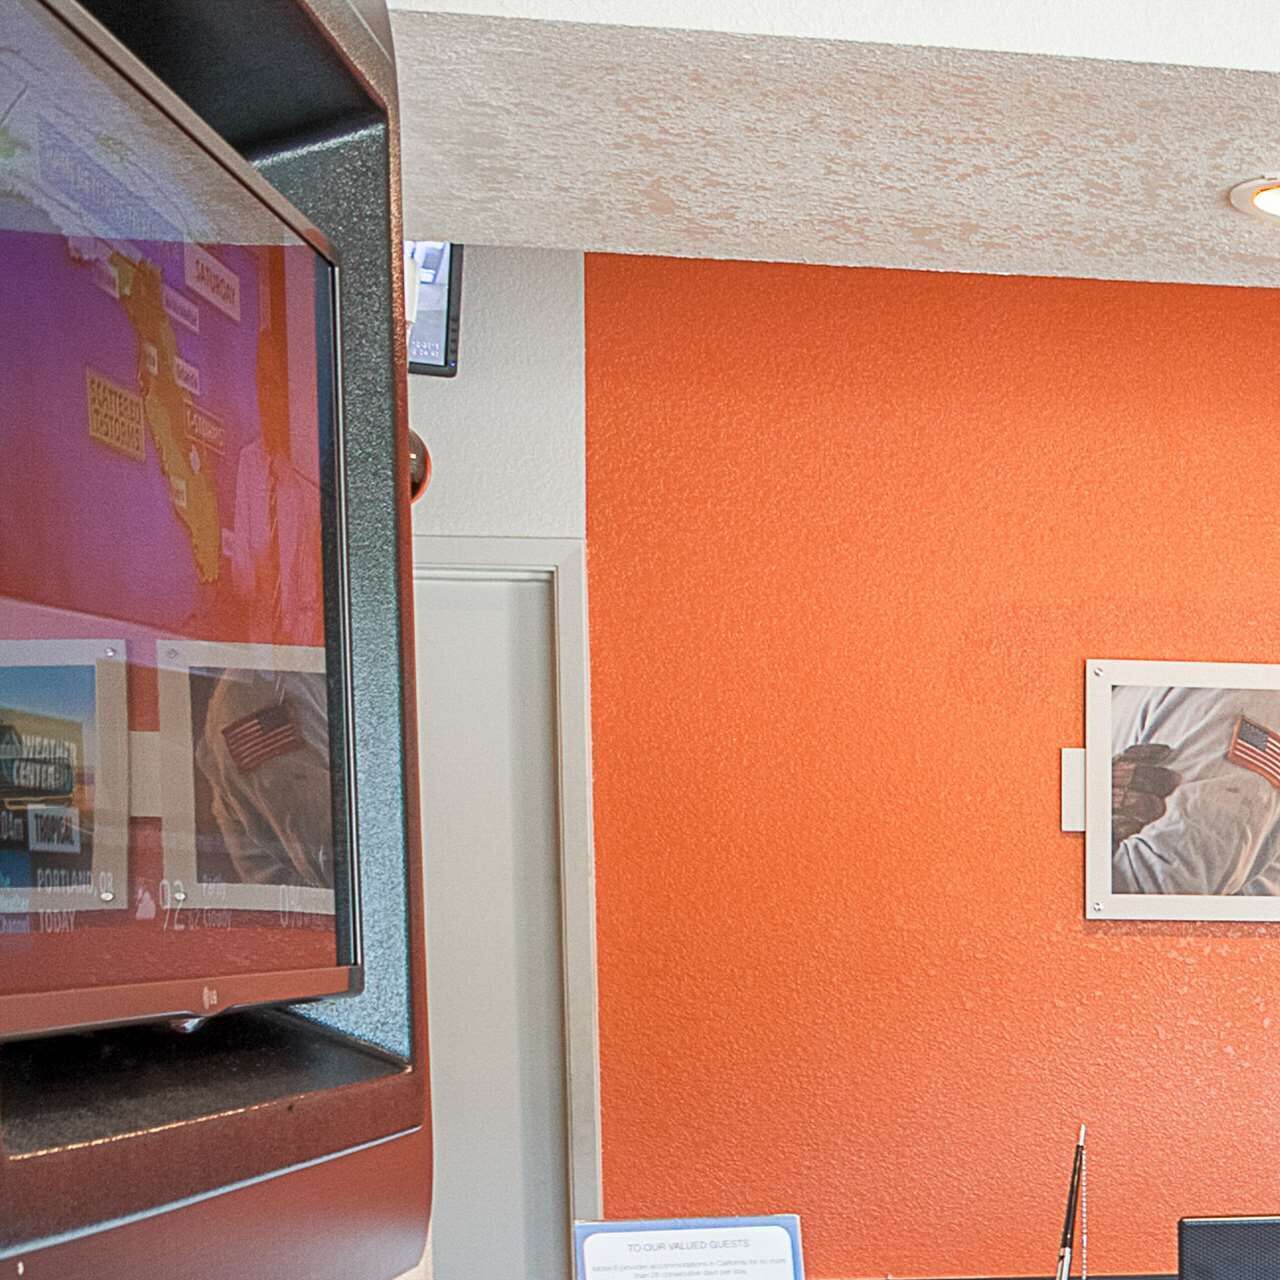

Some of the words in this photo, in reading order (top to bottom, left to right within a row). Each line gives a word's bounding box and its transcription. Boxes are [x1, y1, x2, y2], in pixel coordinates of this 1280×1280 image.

[39, 908, 77, 933] TODAY
[627, 1243, 640, 1253] TO
[643, 1242, 665, 1251] OUR
[668, 1240, 707, 1251] VALUED
